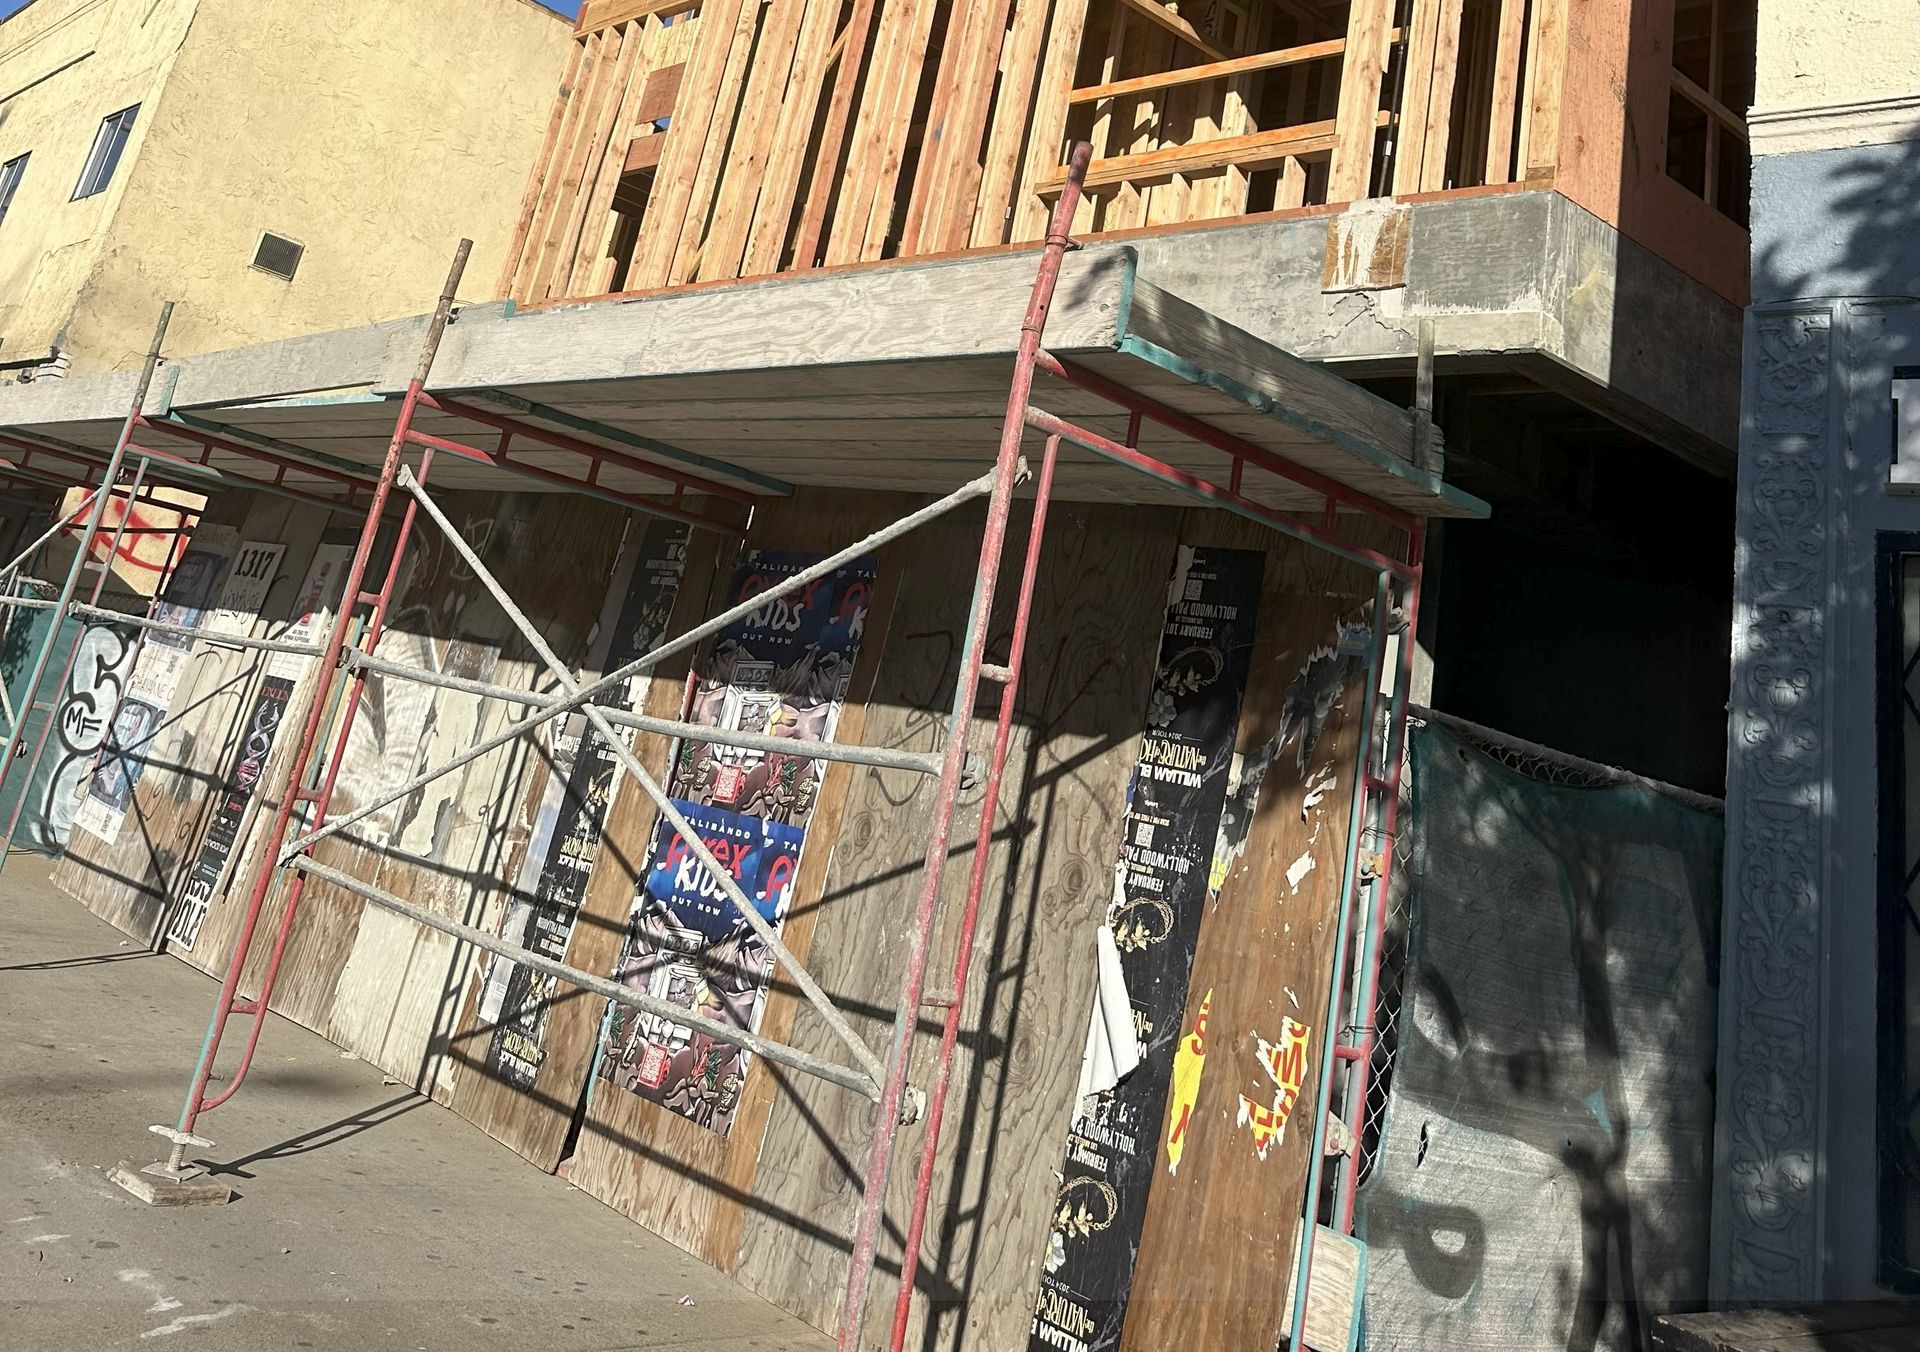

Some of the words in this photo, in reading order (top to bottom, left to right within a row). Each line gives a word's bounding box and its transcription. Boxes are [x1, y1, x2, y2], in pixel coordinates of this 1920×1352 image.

[234, 548, 276, 580] 1317
[1190, 602, 1238, 621] HOLLYWOOD
[742, 633, 763, 641] OUT
[769, 637, 793, 645] NOW
[1179, 623, 1214, 640] FEBRUARY
[1151, 729, 1168, 738] TOUR
[1168, 732, 1182, 740] 2024
[1158, 739, 1200, 771] NATURE
[1154, 765, 1202, 789] WILLIAM
[1140, 849, 1190, 875] HOLLYWOOD
[1127, 872, 1164, 893] FEBRUARY
[671, 895, 692, 907] OUT
[697, 903, 721, 916] NOW
[1084, 1120, 1135, 1155] HOLLYWOOD
[1071, 1143, 1108, 1173] FEBRUARY
[1055, 1280, 1070, 1293] 2024
[1043, 1288, 1088, 1338] NATURE
